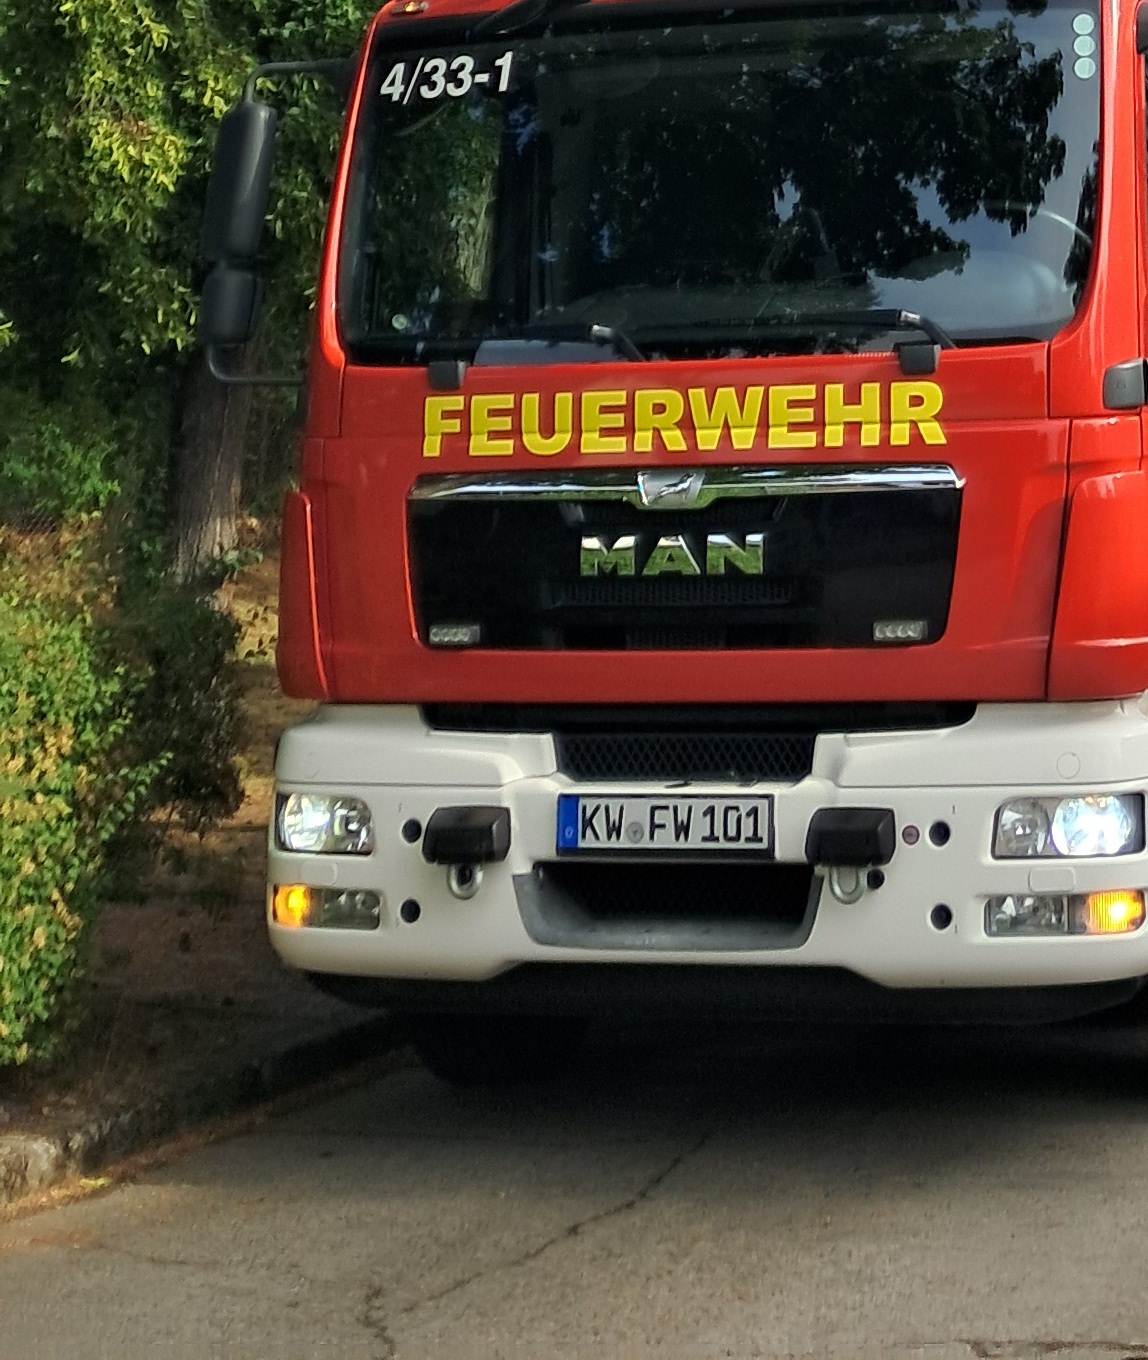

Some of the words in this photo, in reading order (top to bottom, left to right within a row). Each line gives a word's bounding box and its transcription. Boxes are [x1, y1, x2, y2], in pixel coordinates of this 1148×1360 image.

[380, 51, 514, 106] 4/33-1
[422, 380, 948, 458] FEUERWEHR
[579, 531, 765, 578] MAN
[581, 803, 625, 842] KW
[649, 804, 693, 843] FW
[701, 804, 764, 844] 101
